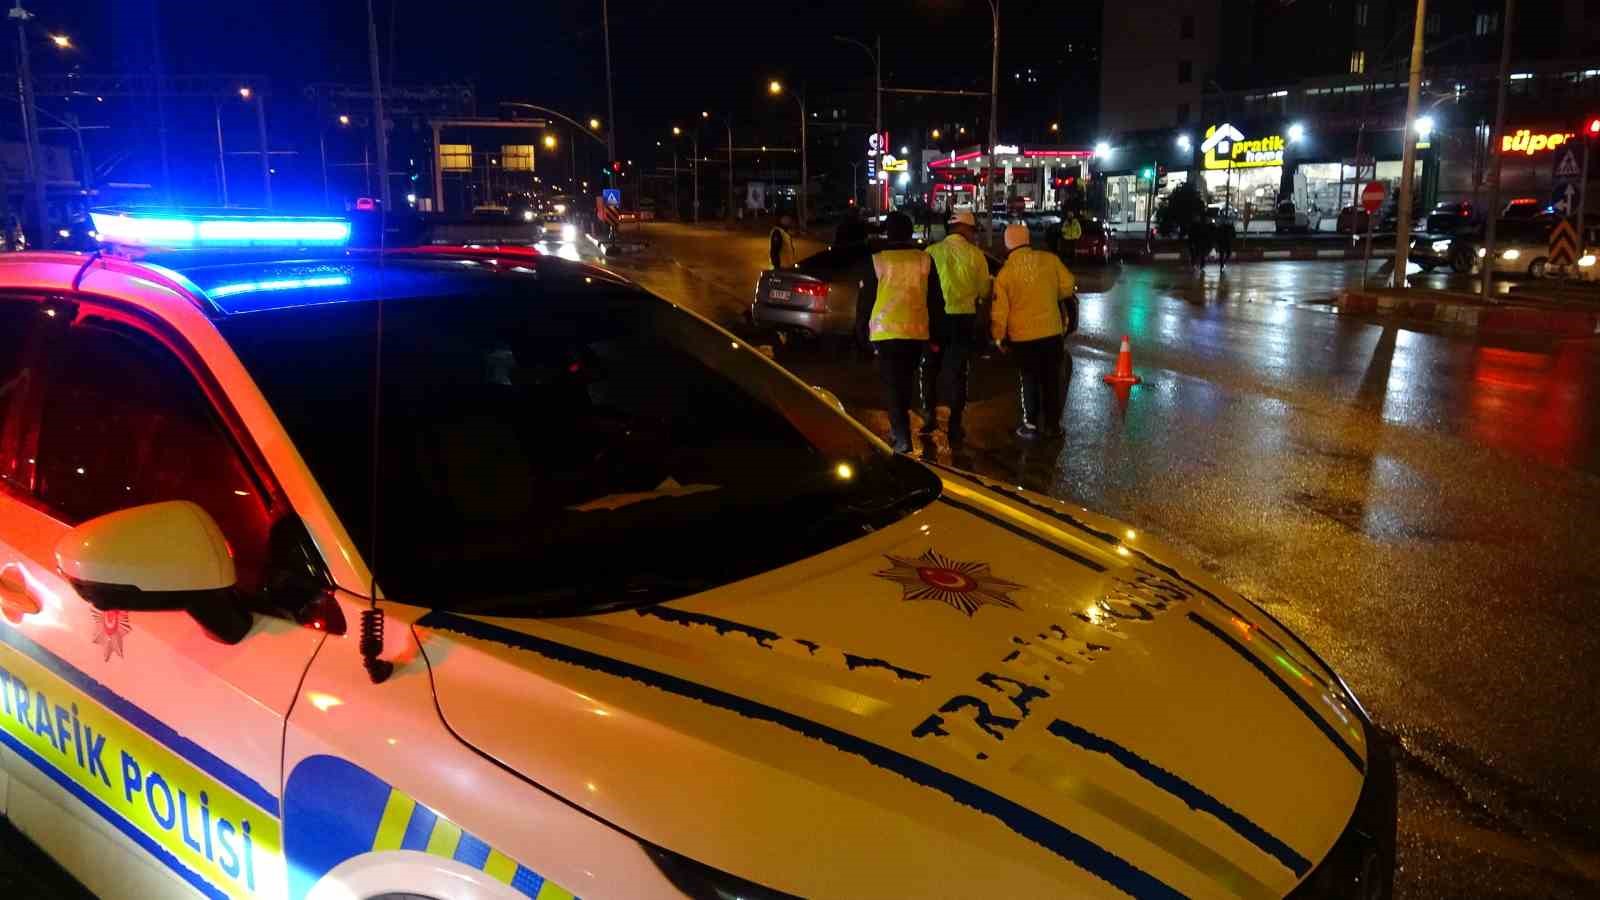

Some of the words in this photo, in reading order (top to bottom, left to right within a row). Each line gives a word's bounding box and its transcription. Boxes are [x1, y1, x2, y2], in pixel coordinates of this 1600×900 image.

[1232, 137, 1285, 159] pratik
[0, 666, 111, 788] TRAFİK
[120, 749, 255, 892] POLİSİ
